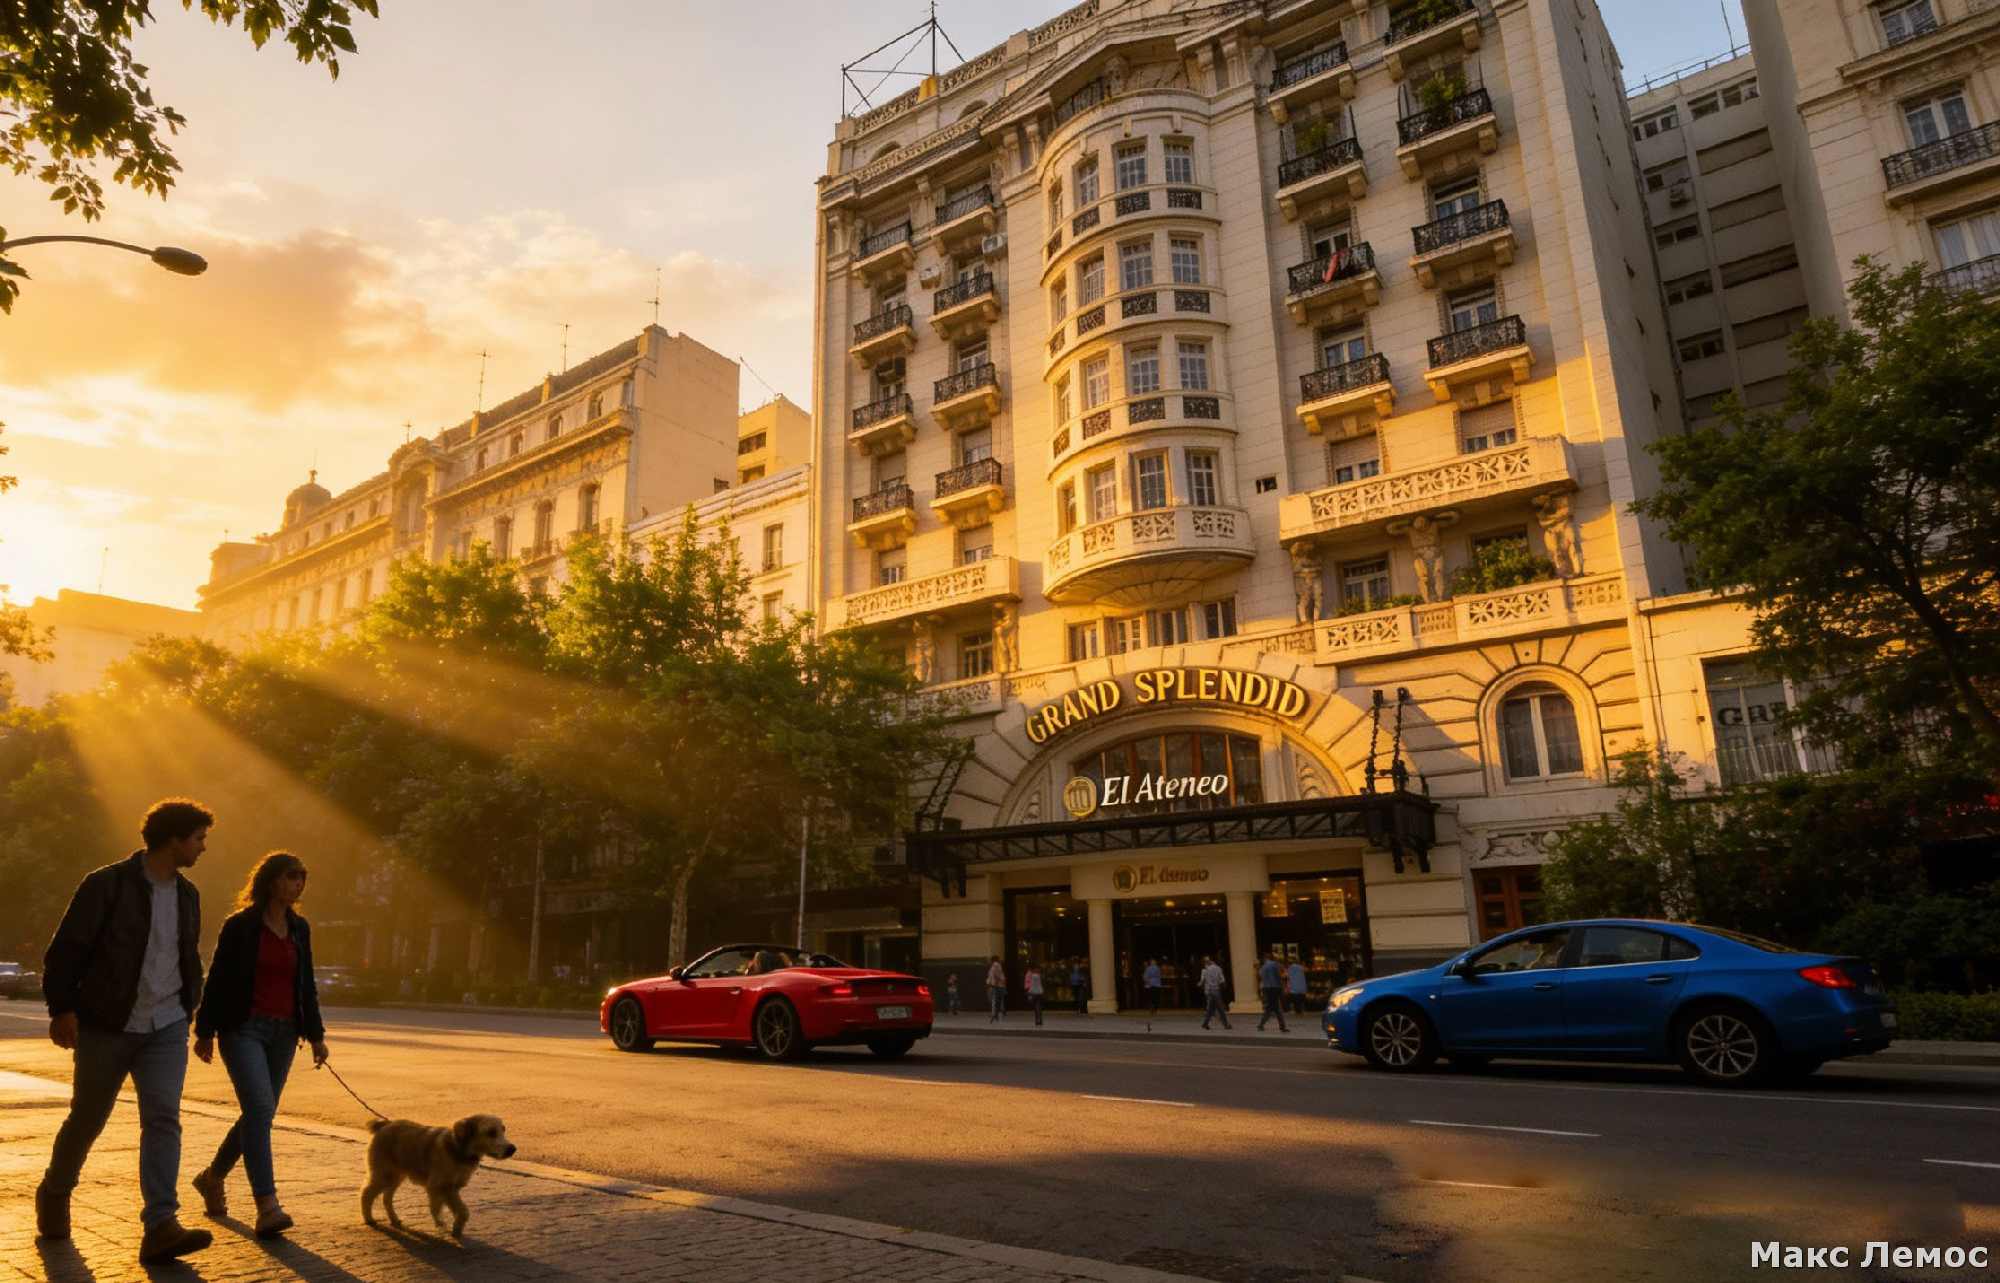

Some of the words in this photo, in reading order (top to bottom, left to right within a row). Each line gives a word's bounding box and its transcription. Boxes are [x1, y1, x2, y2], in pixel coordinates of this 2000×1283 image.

[1026, 680, 1121, 743] GRAND
[1134, 668, 1306, 718] SPLENDID
[1101, 775, 1130, 807] El
[1135, 772, 1228, 804] Ateneo
